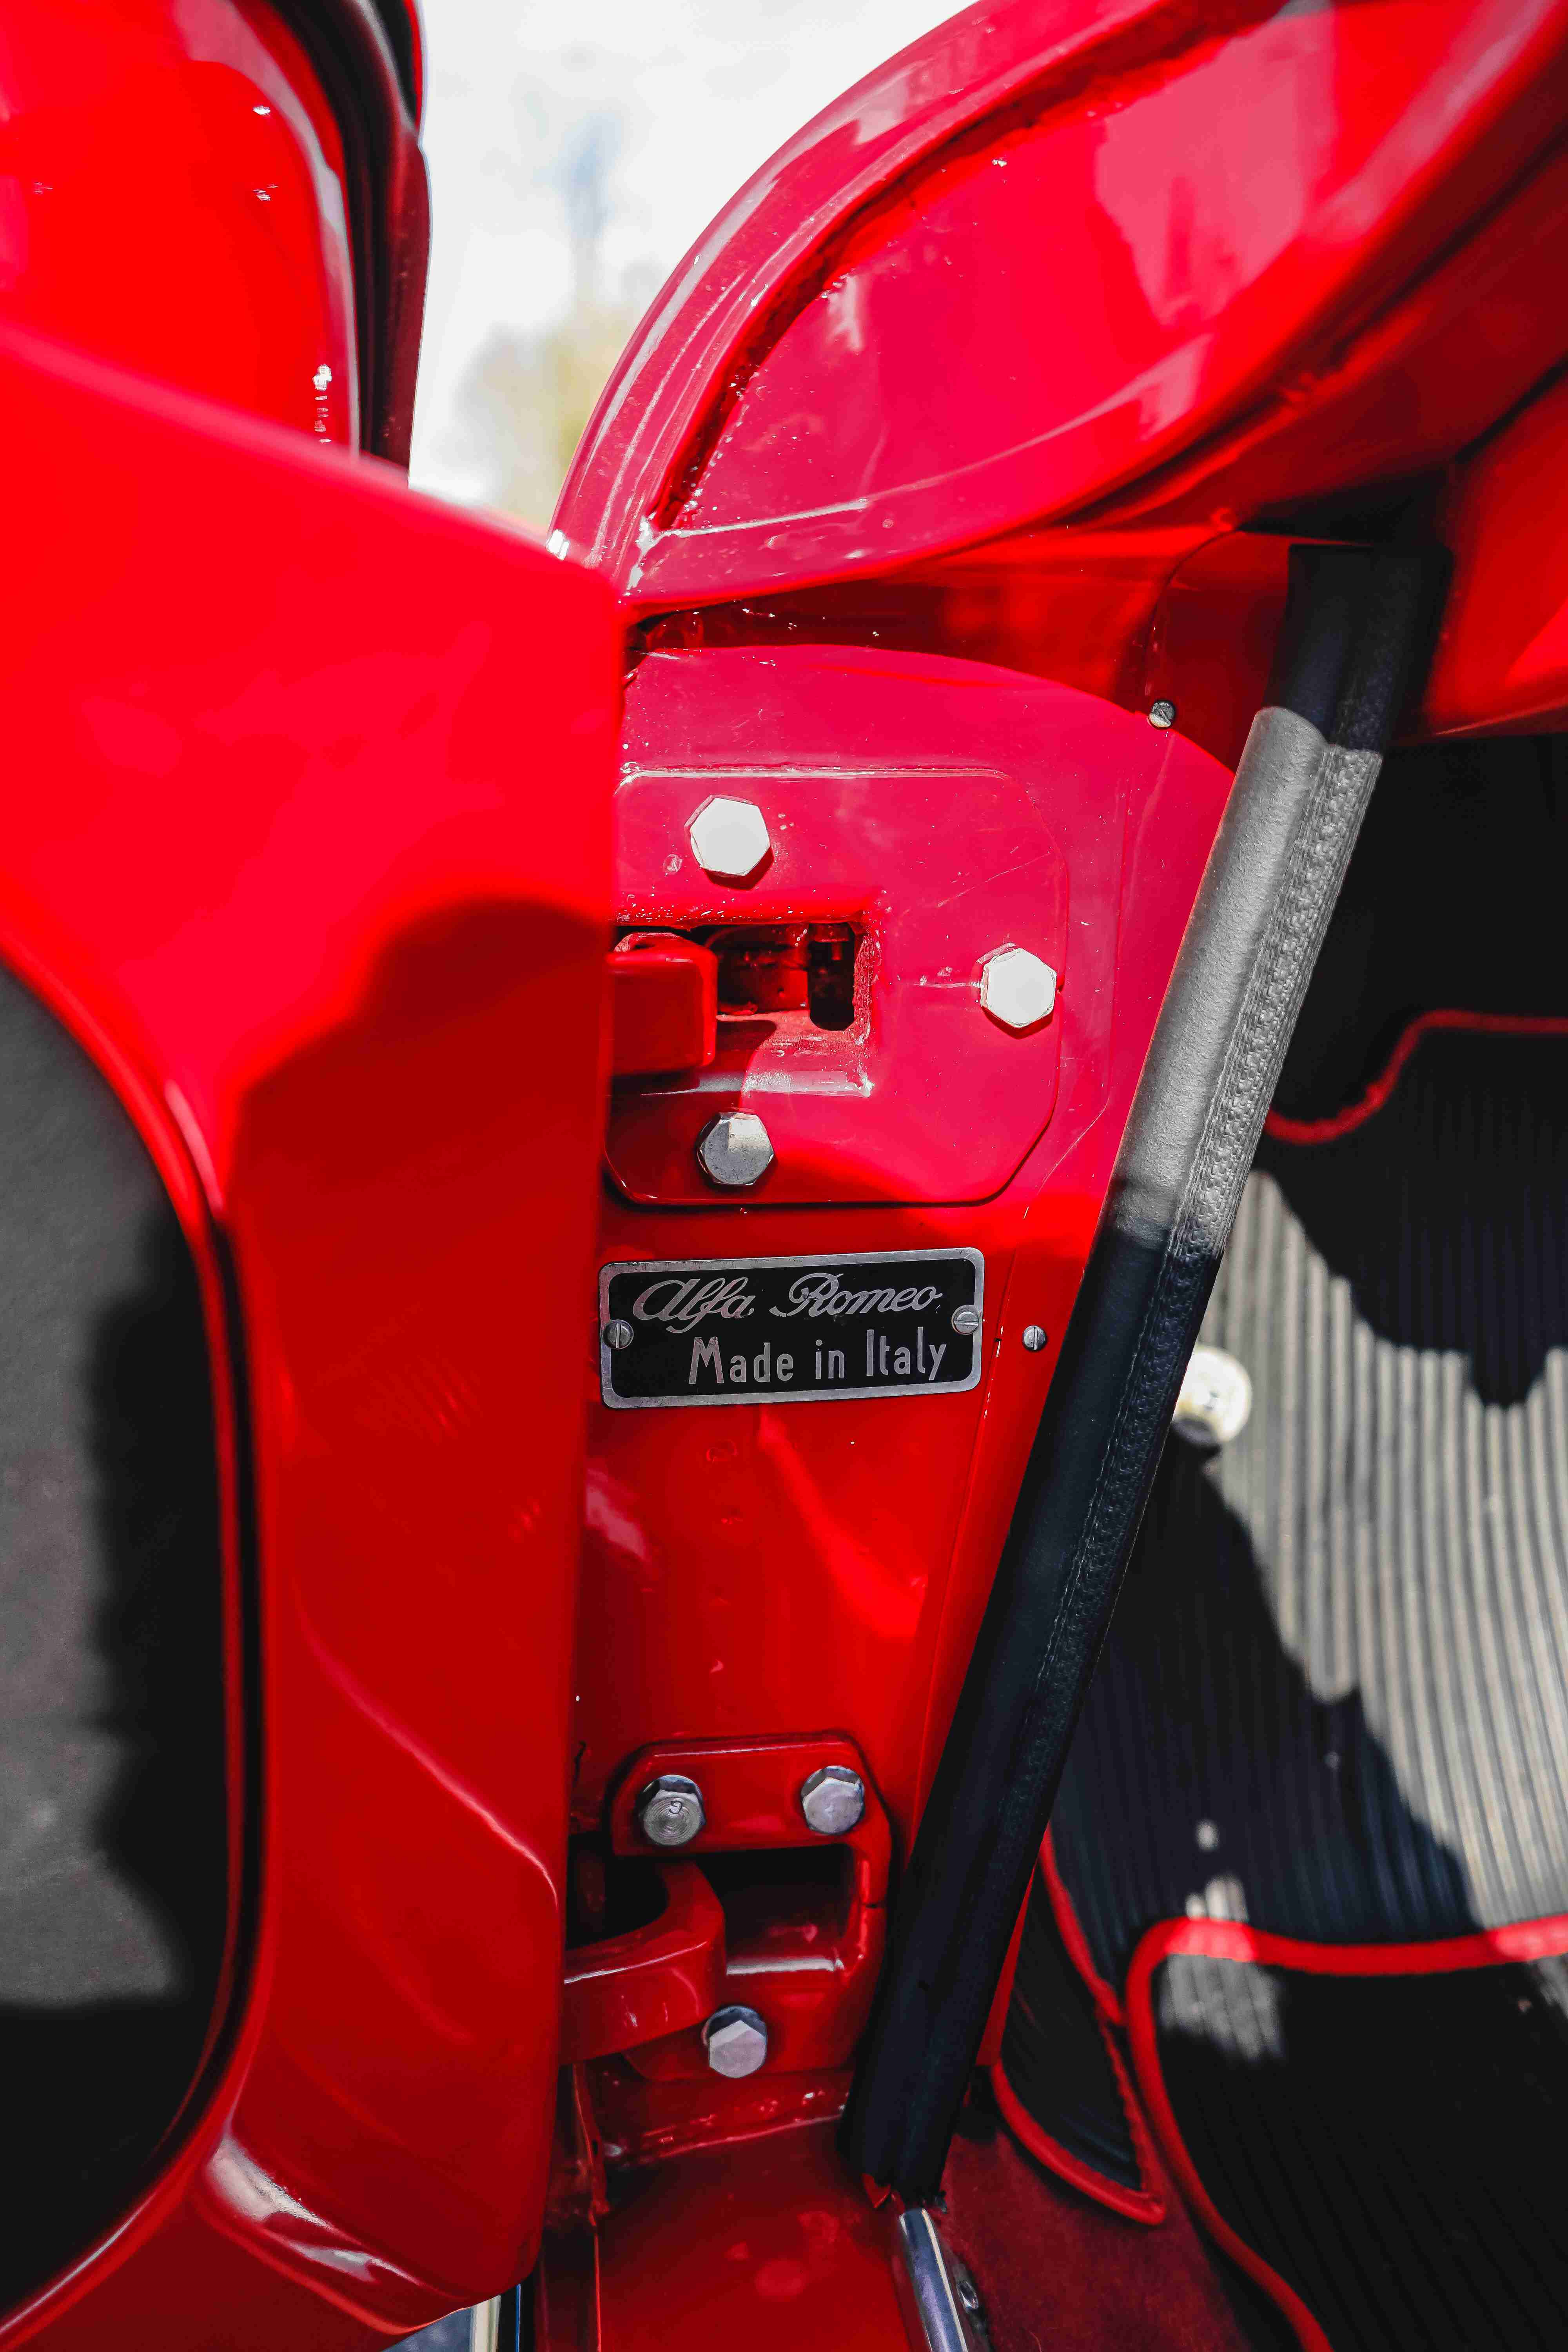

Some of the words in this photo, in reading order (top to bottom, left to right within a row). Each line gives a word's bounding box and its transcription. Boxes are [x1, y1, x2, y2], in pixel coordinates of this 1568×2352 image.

[632, 1277, 756, 1334] Alfa
[769, 1272, 943, 1318] Romeo
[688, 1336, 793, 1384] Made
[815, 1339, 845, 1379] in
[866, 1326, 947, 1381] Italy
